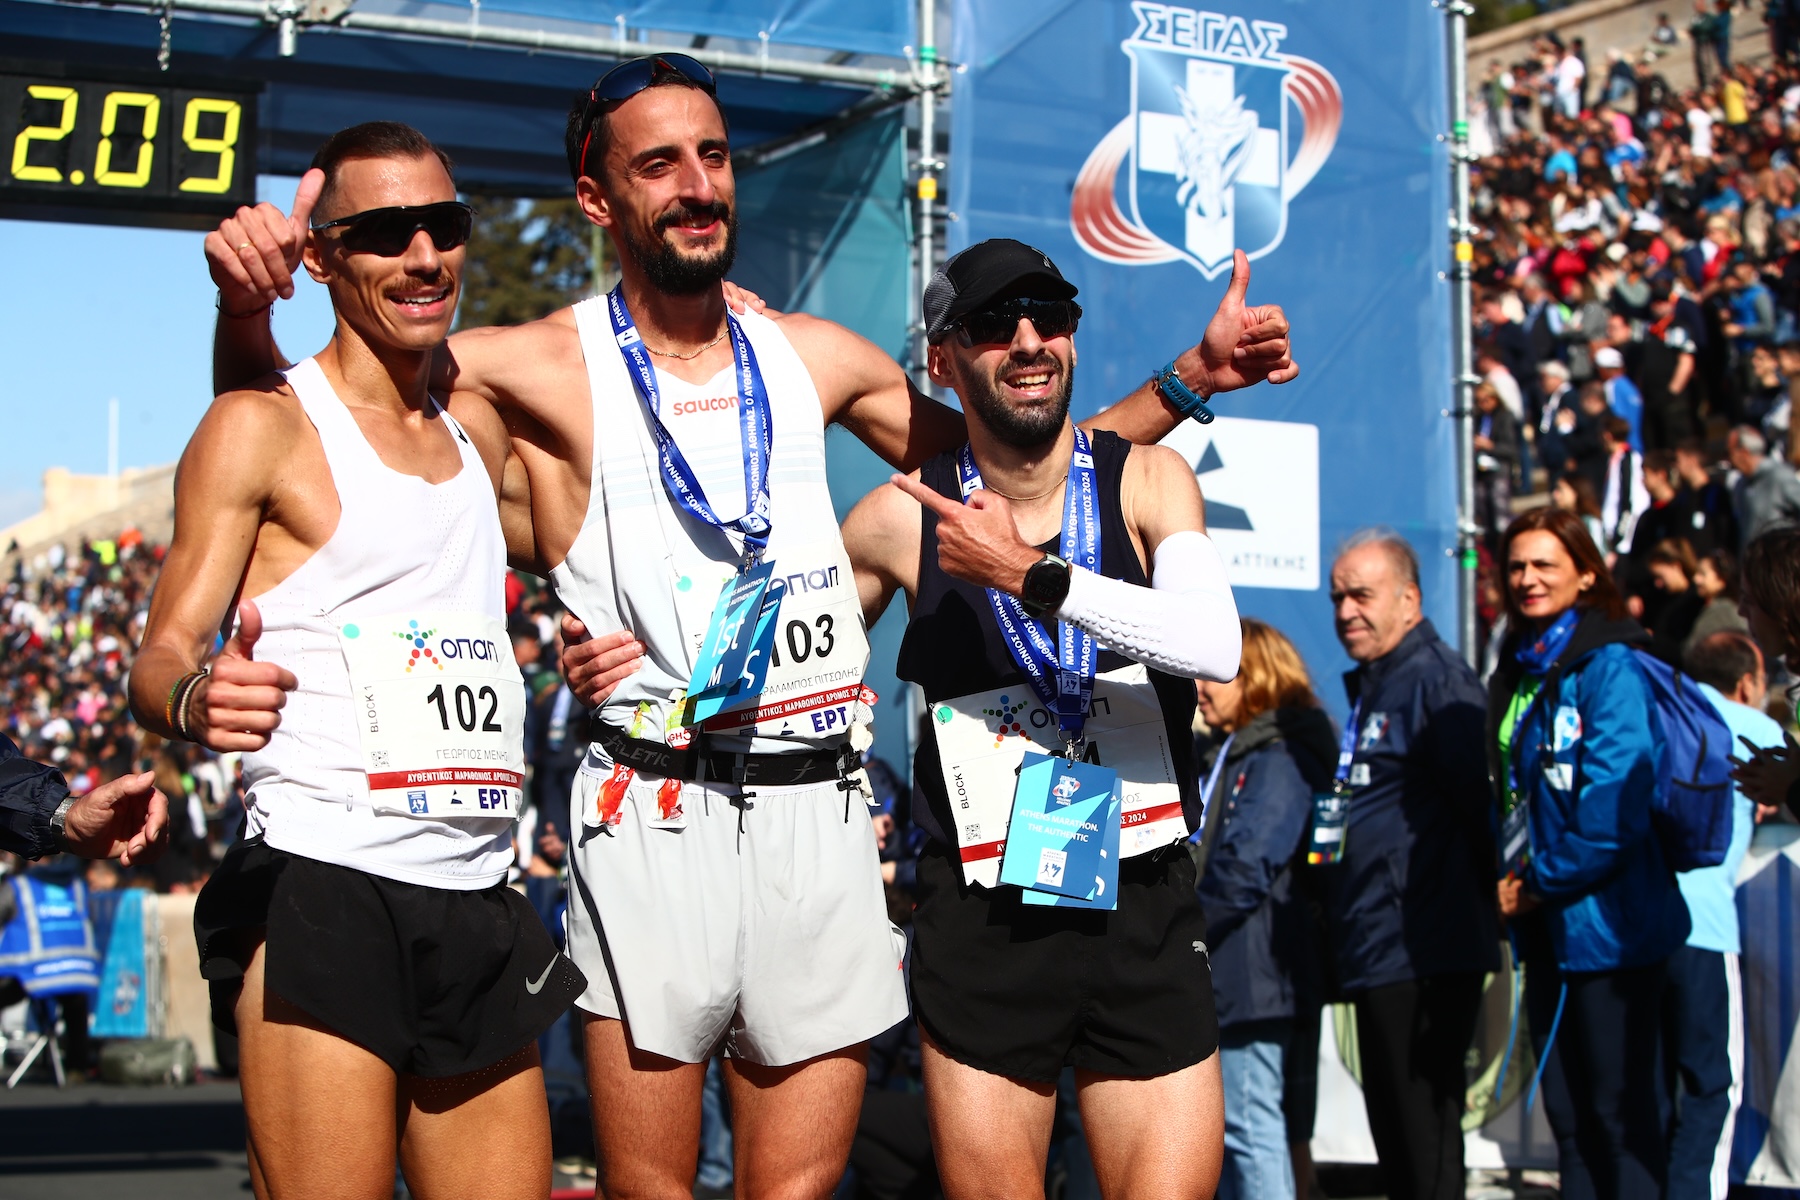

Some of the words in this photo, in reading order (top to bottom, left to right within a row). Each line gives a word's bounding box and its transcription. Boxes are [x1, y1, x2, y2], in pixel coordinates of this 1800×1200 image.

[1130, 1, 1288, 61] ΣΕΓΑΣ
[611, 294, 628, 327] ATHENS
[630, 347, 646, 365] 2024
[737, 341, 754, 397] ΑΥΘΕΝΤΙΚΟΣ
[673, 395, 740, 416] saucon
[1072, 424, 1087, 451] ATHEN
[1081, 472, 1091, 494] 2024
[1082, 494, 1095, 556] ΑΥΘΕΝΤΙΚΟΣ
[814, 666, 860, 685] ΠΙΤΣΩΛΗΣ
[364, 693, 379, 733] BLOCK
[427, 684, 502, 732] 102
[741, 703, 783, 722] ΑΥΘΕΝΤΙΚΟΣ
[784, 695, 826, 713] ΜΑΡΑΘΩΝΙΟΣ
[826, 688, 850, 703] ΔΡΟΜΟΣ
[436, 748, 482, 760] ΓΕΩΡΓΙΟΣ
[407, 770, 453, 783] ΑΥΘΕΝΤΙΚΟΣ
[953, 773, 970, 809] BLOCK
[1020, 809, 1050, 821] ATHENS
[1051, 816, 1098, 832] MARATHON.
[1129, 812, 1147, 823] 2024
[1028, 823, 1044, 833] THE
[1044, 827, 1089, 842] AUTHENTIC
